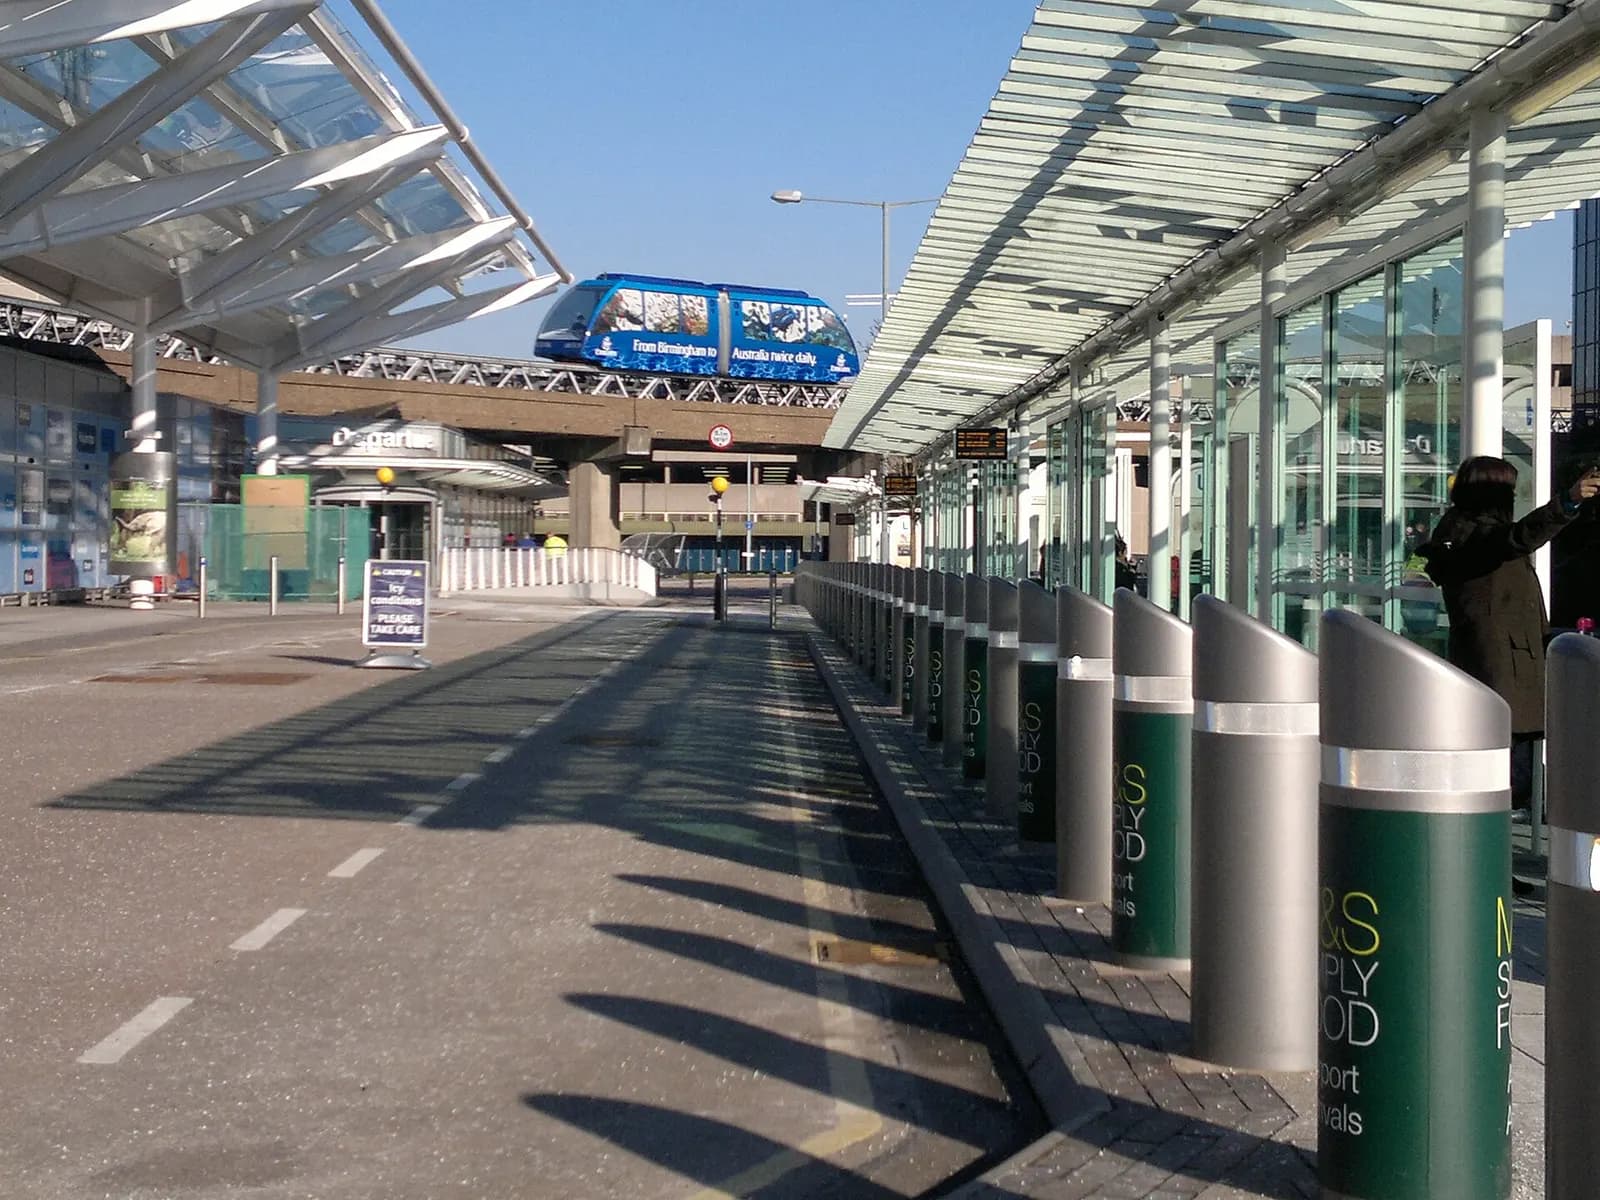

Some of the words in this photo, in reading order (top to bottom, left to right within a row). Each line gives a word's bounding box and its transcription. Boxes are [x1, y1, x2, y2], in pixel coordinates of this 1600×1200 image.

[633, 339, 656, 353] From
[658, 342, 707, 358] Birmingham
[708, 347, 717, 357] to
[732, 347, 769, 361] Australia
[771, 351, 793, 363] twice
[389, 584, 404, 595] Icy
[371, 595, 423, 605] conditions
[378, 614, 415, 624] PLEASE
[370, 625, 395, 634] TAKE
[396, 625, 422, 634] CARE
[1319, 953, 1379, 998] PLY
[1319, 995, 1380, 1047] OD
